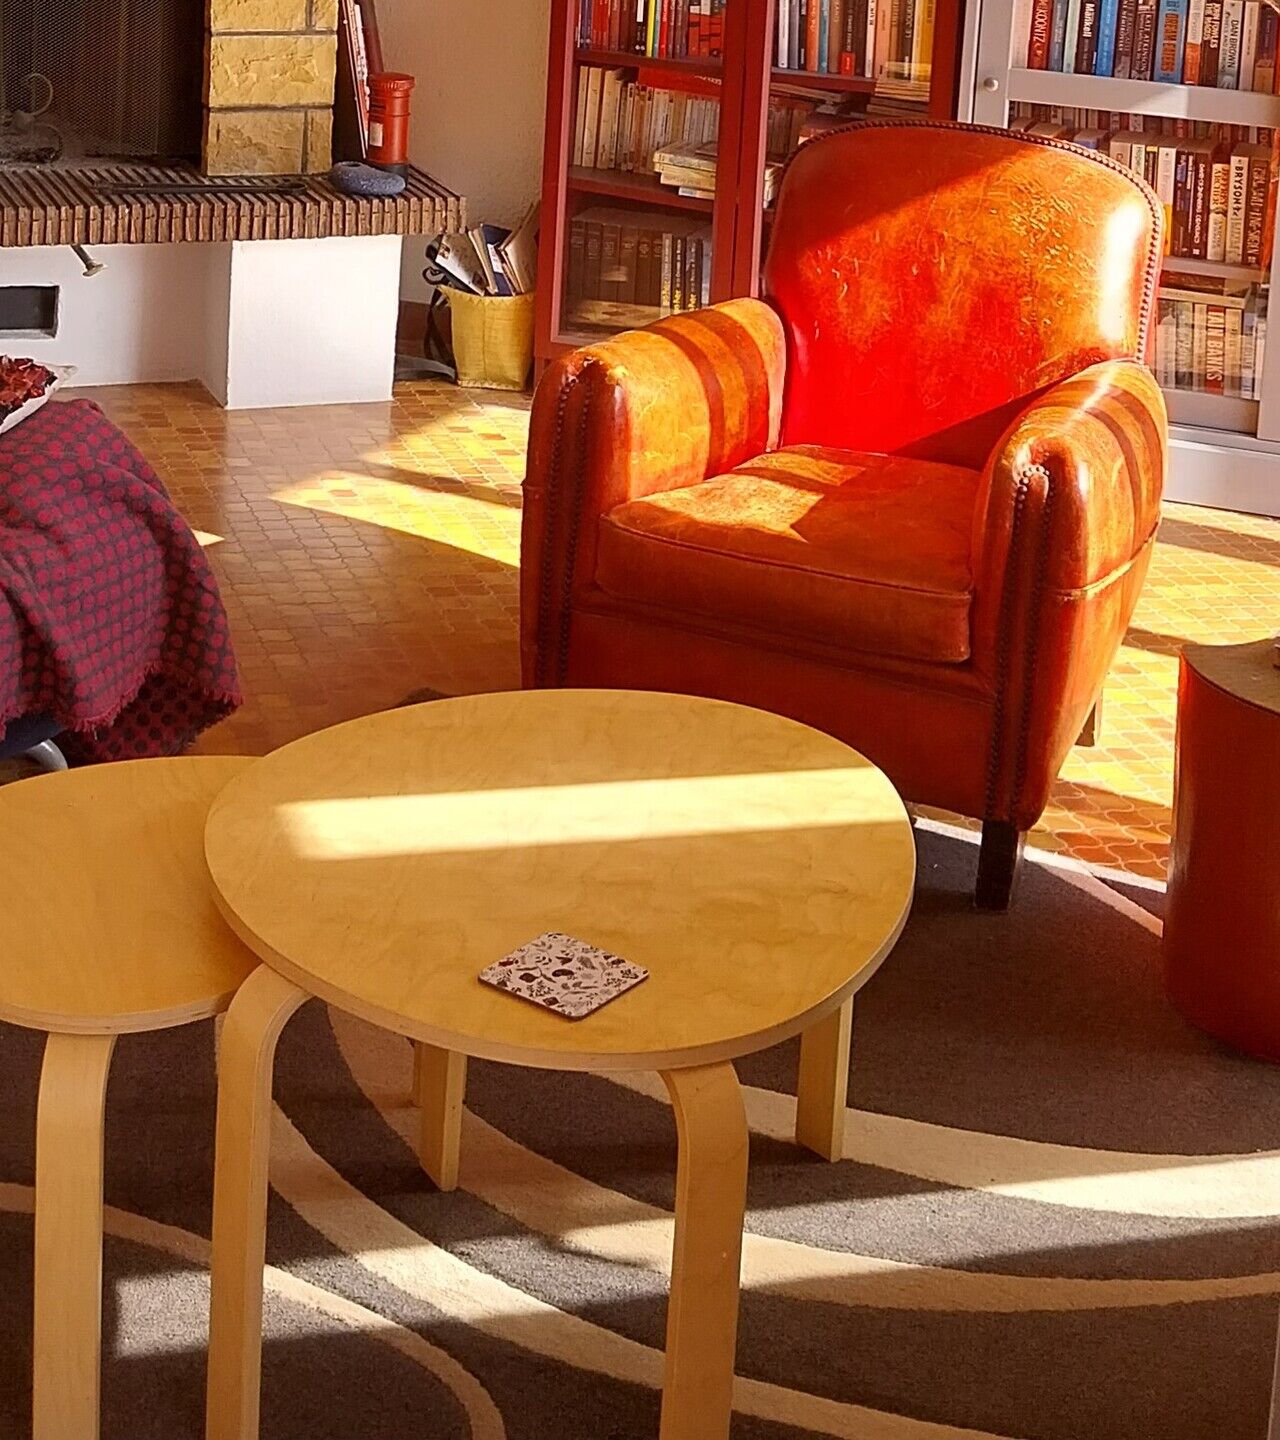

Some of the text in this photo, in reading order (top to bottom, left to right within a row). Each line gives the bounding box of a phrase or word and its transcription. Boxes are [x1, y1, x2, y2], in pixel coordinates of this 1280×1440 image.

[905, 29, 912, 38] LE
[1033, 9, 1048, 42] KOONTZ
[1082, 3, 1094, 38] Mankell
[1210, 21, 1220, 48] FOWLES
[1141, 14, 1152, 71] KATE ATKINSON
[1227, 20, 1239, 68] DAN BROWN
[1212, 169, 1221, 206] ARCHER
[1220, 167, 1229, 207] JEFFREY
[1233, 166, 1244, 205] BRYSON
[1206, 312, 1224, 381] IAIN BANKS
